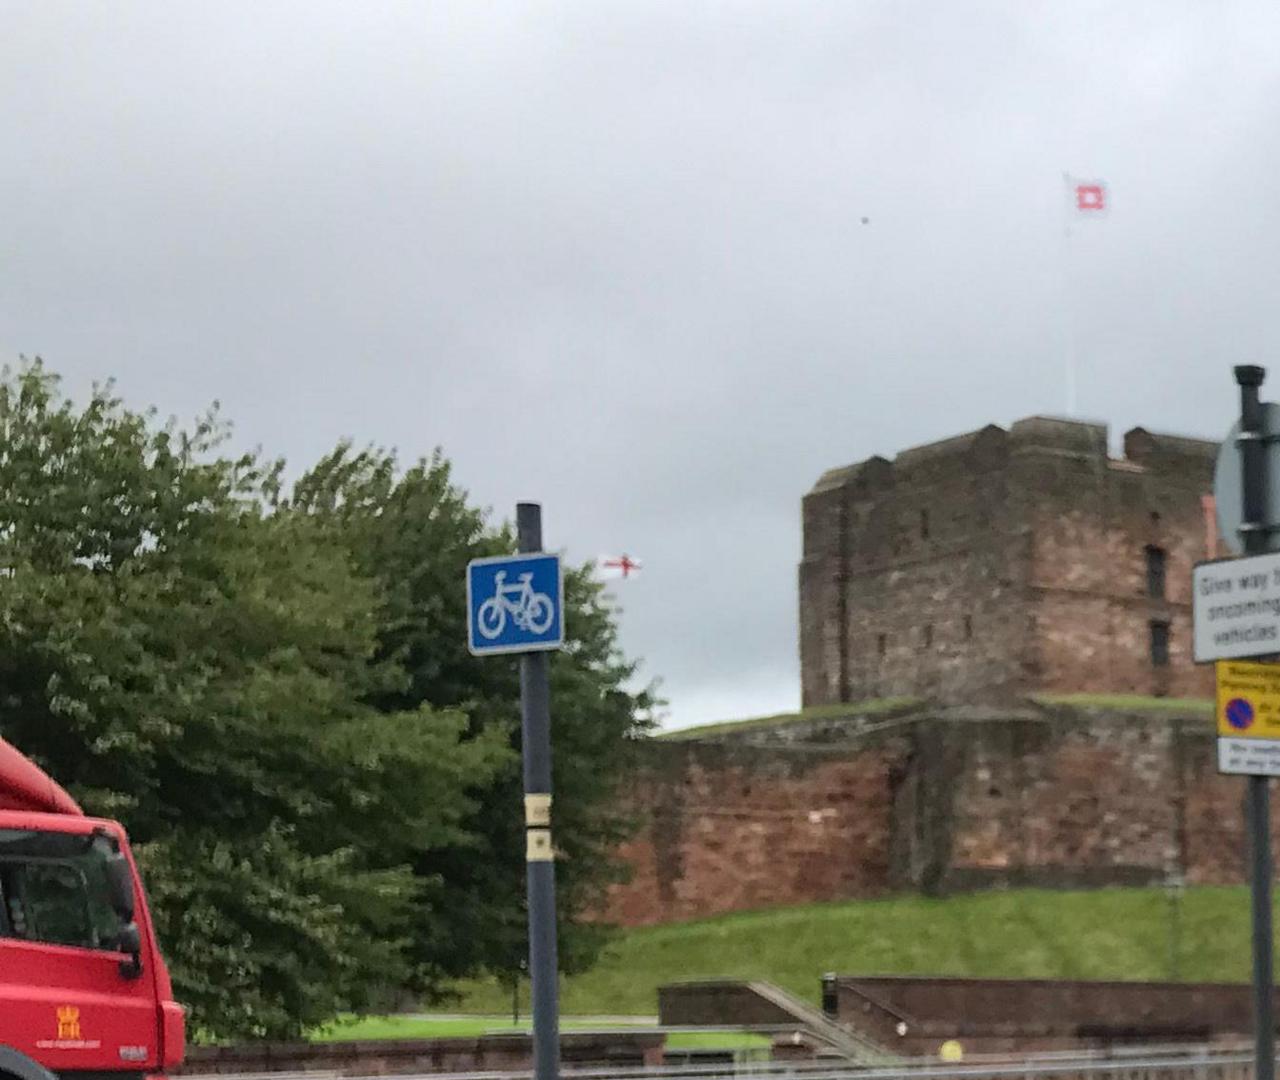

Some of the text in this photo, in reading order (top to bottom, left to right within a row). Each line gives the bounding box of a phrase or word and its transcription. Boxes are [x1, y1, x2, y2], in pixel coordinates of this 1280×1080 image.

[1199, 576, 1232, 597] Give
[1238, 573, 1268, 591] way
[1213, 625, 1278, 645] vehicles
